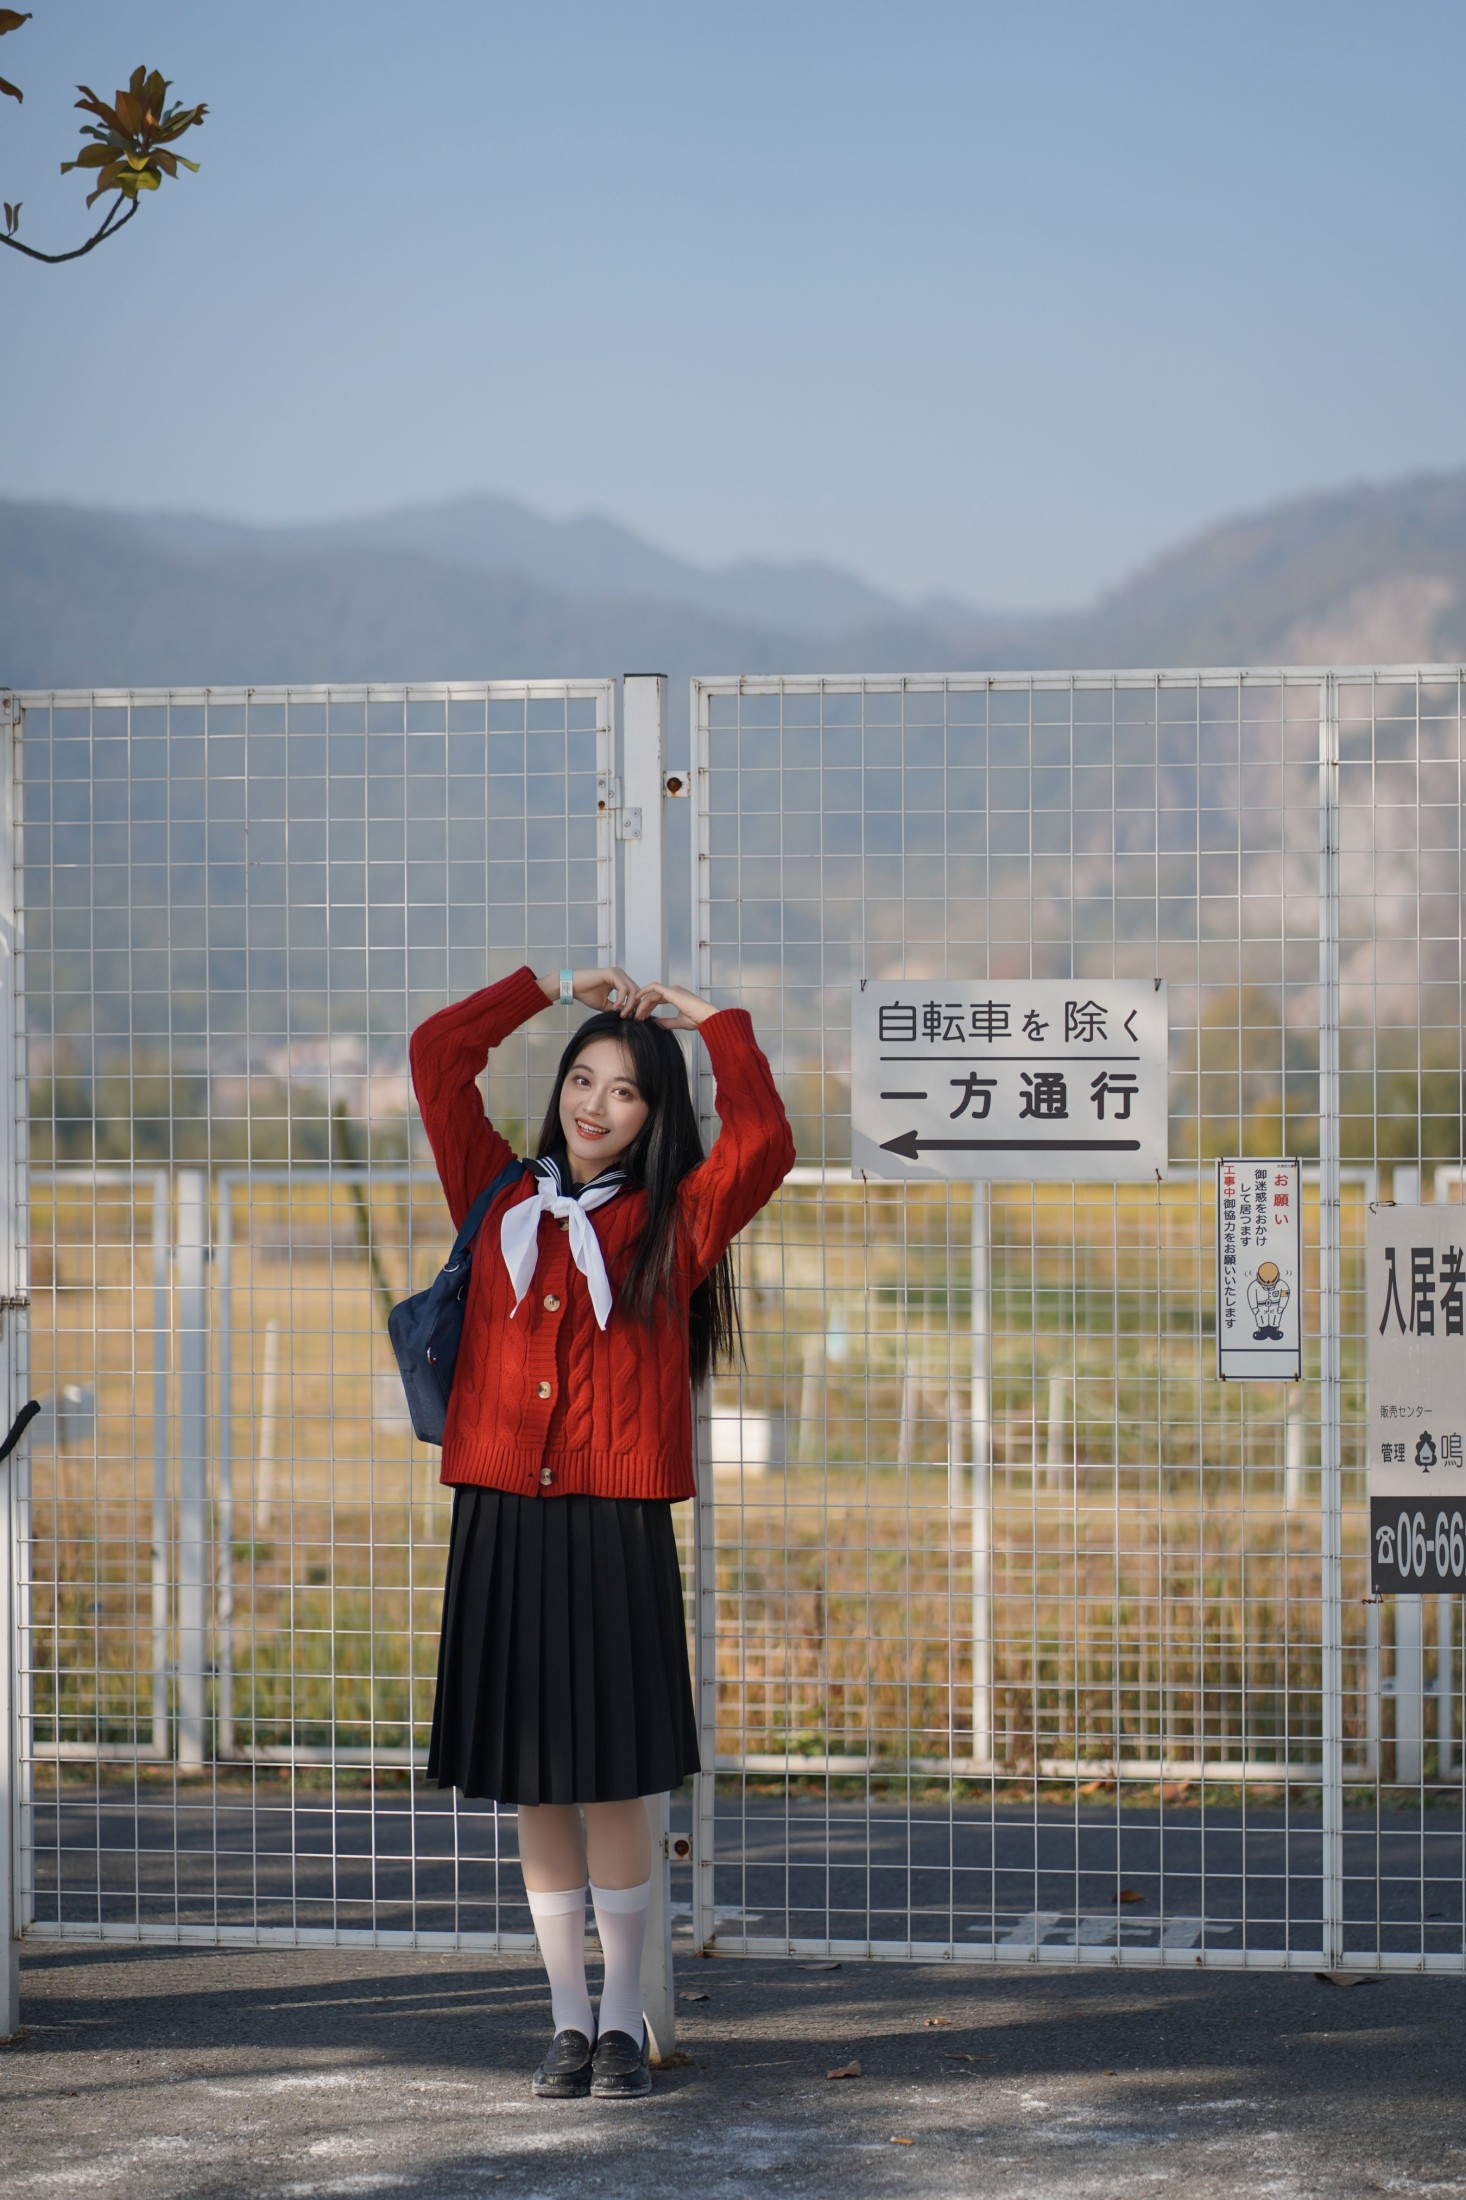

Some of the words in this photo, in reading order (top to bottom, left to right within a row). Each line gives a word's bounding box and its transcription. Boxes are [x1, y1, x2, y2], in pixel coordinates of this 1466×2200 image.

[879, 999, 1139, 1044] 自転車を除く
[880, 1071, 1139, 1121] 一方通行
[1254, 1168, 1268, 1247] 御迷惑をおかけ
[1273, 1173, 1290, 1225] お願い
[1223, 1165, 1237, 1329] 工事中御協力をお願いいたします
[1379, 1245, 1466, 1337] 入居者
[1380, 1404, 1433, 1419] 販売センター
[1381, 1442, 1406, 1463] 管理
[1397, 1511, 1466, 1578] 06-66
